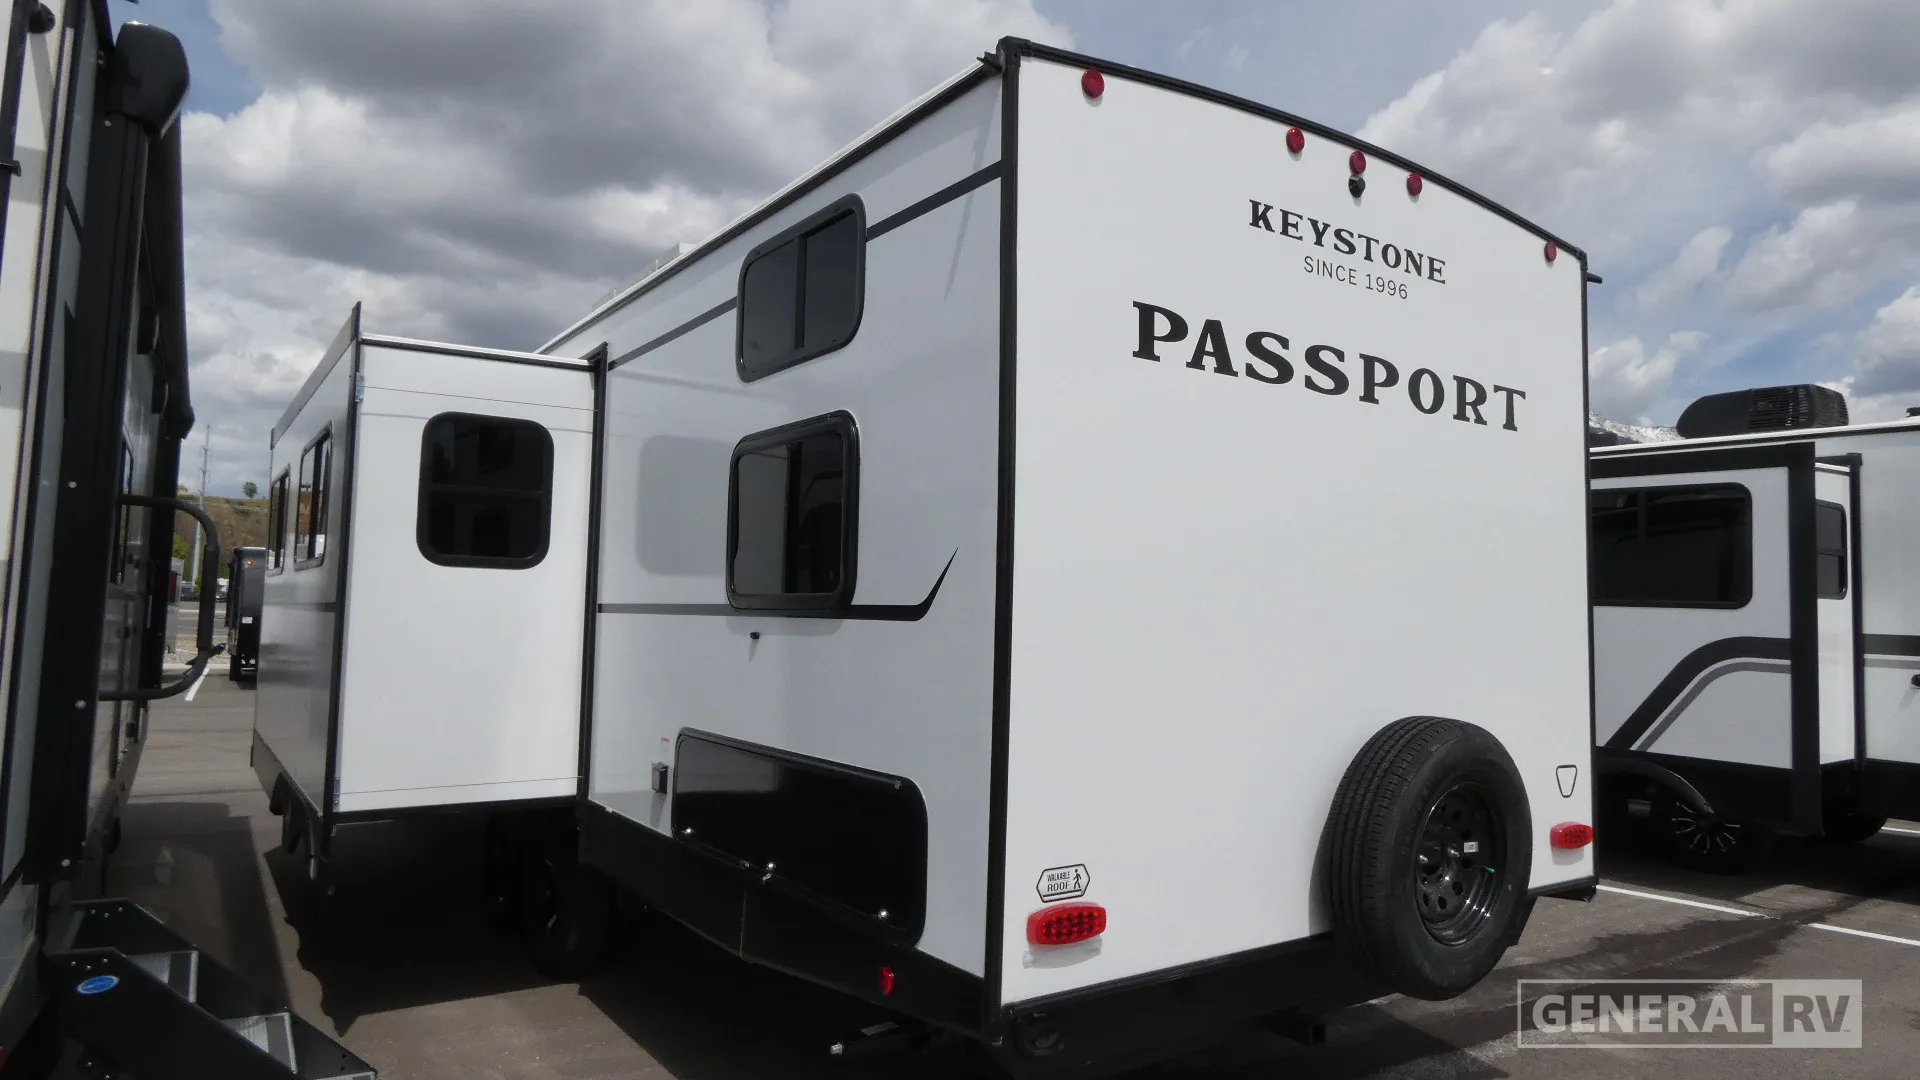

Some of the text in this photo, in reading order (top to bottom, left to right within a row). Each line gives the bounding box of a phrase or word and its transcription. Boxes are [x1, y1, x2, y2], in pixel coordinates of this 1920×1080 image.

[1249, 200, 1446, 285] KEYSTONE
[1304, 256, 1408, 300] SINCE 1996
[1133, 301, 1526, 432] PASSPORT
[1047, 871, 1070, 882] WALKABLE
[1047, 881, 1070, 892] ROOF
